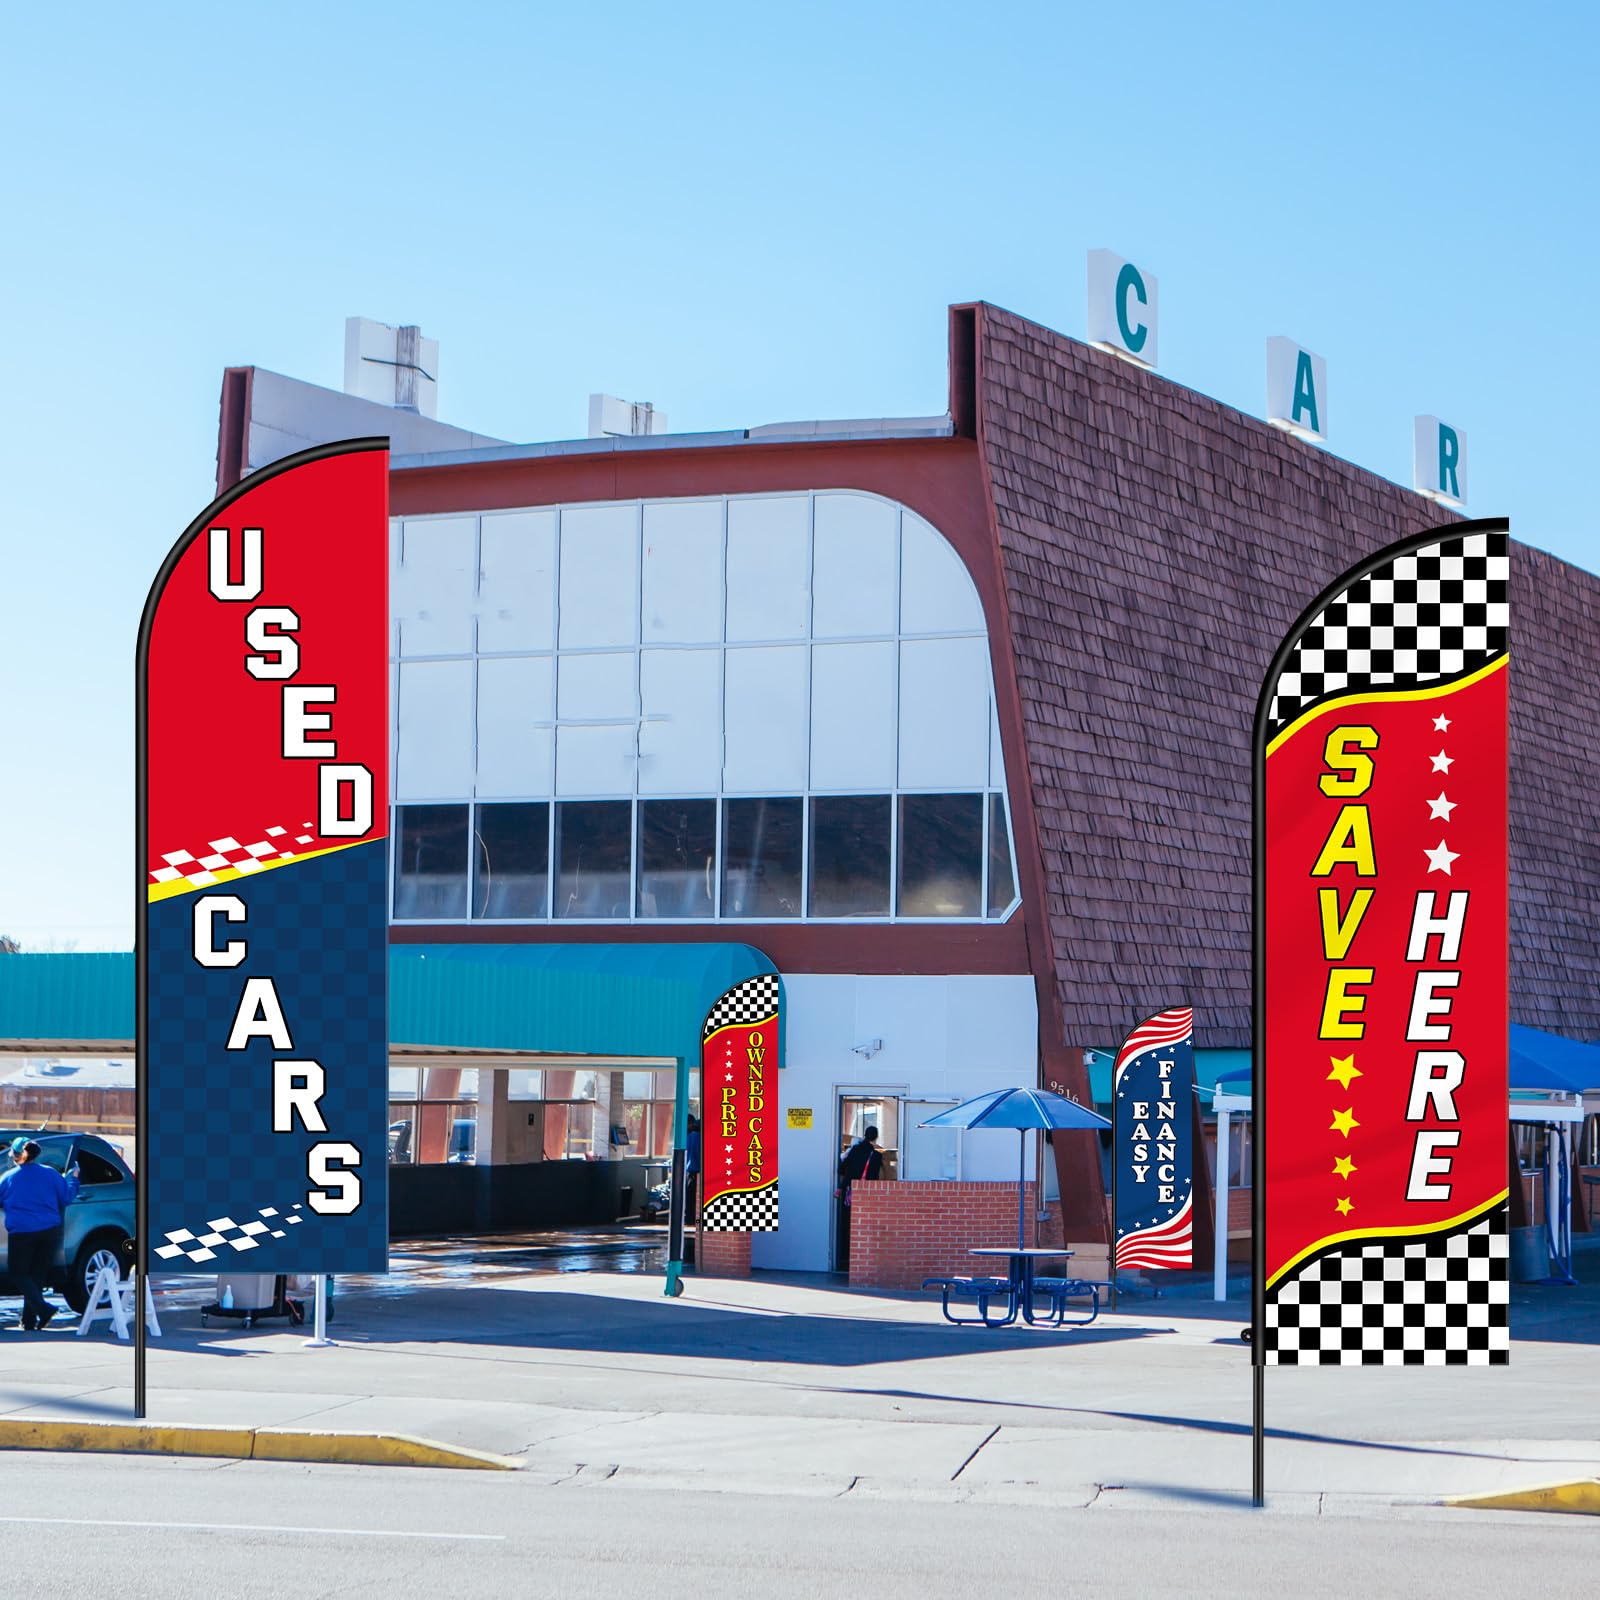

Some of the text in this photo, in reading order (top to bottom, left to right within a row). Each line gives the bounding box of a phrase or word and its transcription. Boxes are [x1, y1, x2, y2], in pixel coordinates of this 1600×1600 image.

[1115, 263, 1460, 499] CAR
[207, 528, 374, 838] USED
[1311, 724, 1378, 1040] SAVE
[192, 895, 363, 1216] CARS
[721, 1087, 738, 1138] PRE
[747, 1031, 765, 1184] OWNED CARS
[1050, 1080, 1079, 1103] 9516
[1130, 1101, 1151, 1183] EASY
[1156, 1060, 1176, 1204] FINANCE
[1405, 890, 1469, 1201] HERE
